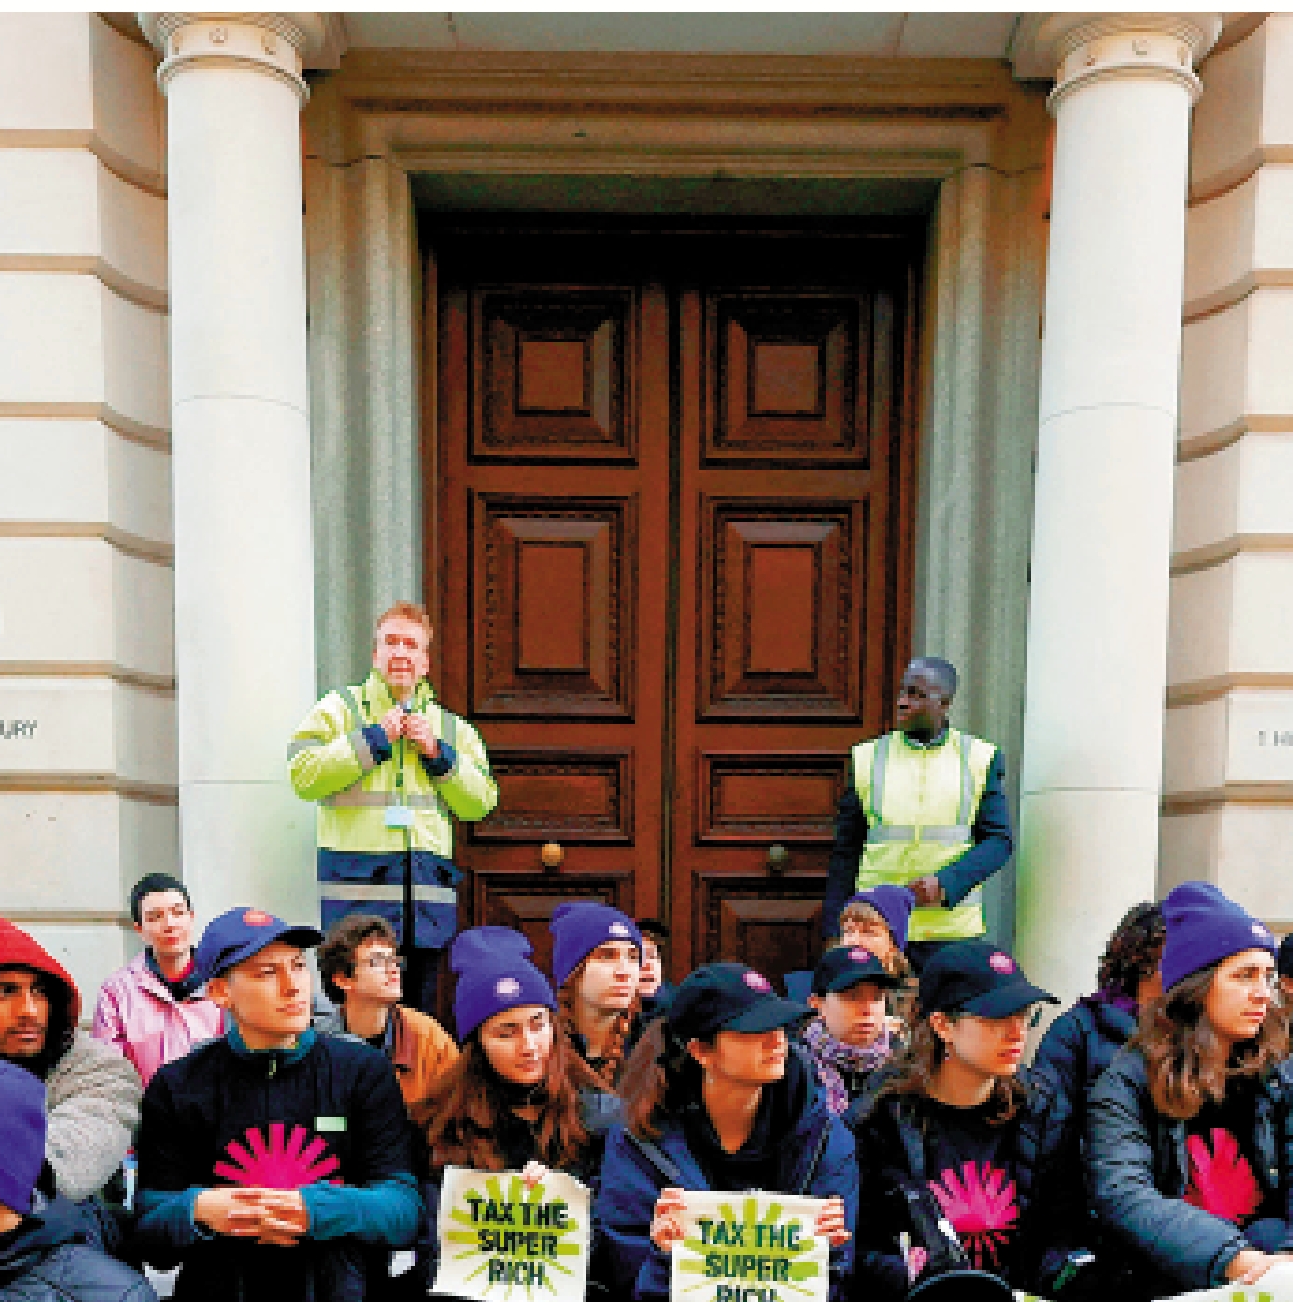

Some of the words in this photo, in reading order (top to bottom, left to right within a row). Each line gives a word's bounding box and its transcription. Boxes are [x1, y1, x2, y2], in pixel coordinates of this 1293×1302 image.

[466, 1198, 514, 1224] TAX
[519, 1202, 569, 1230] THE
[478, 1229, 557, 1259] SUPER
[696, 1218, 745, 1246] TAX
[754, 1223, 803, 1251] THE
[488, 1258, 544, 1288] RICH
[705, 1253, 791, 1281] SUPER
